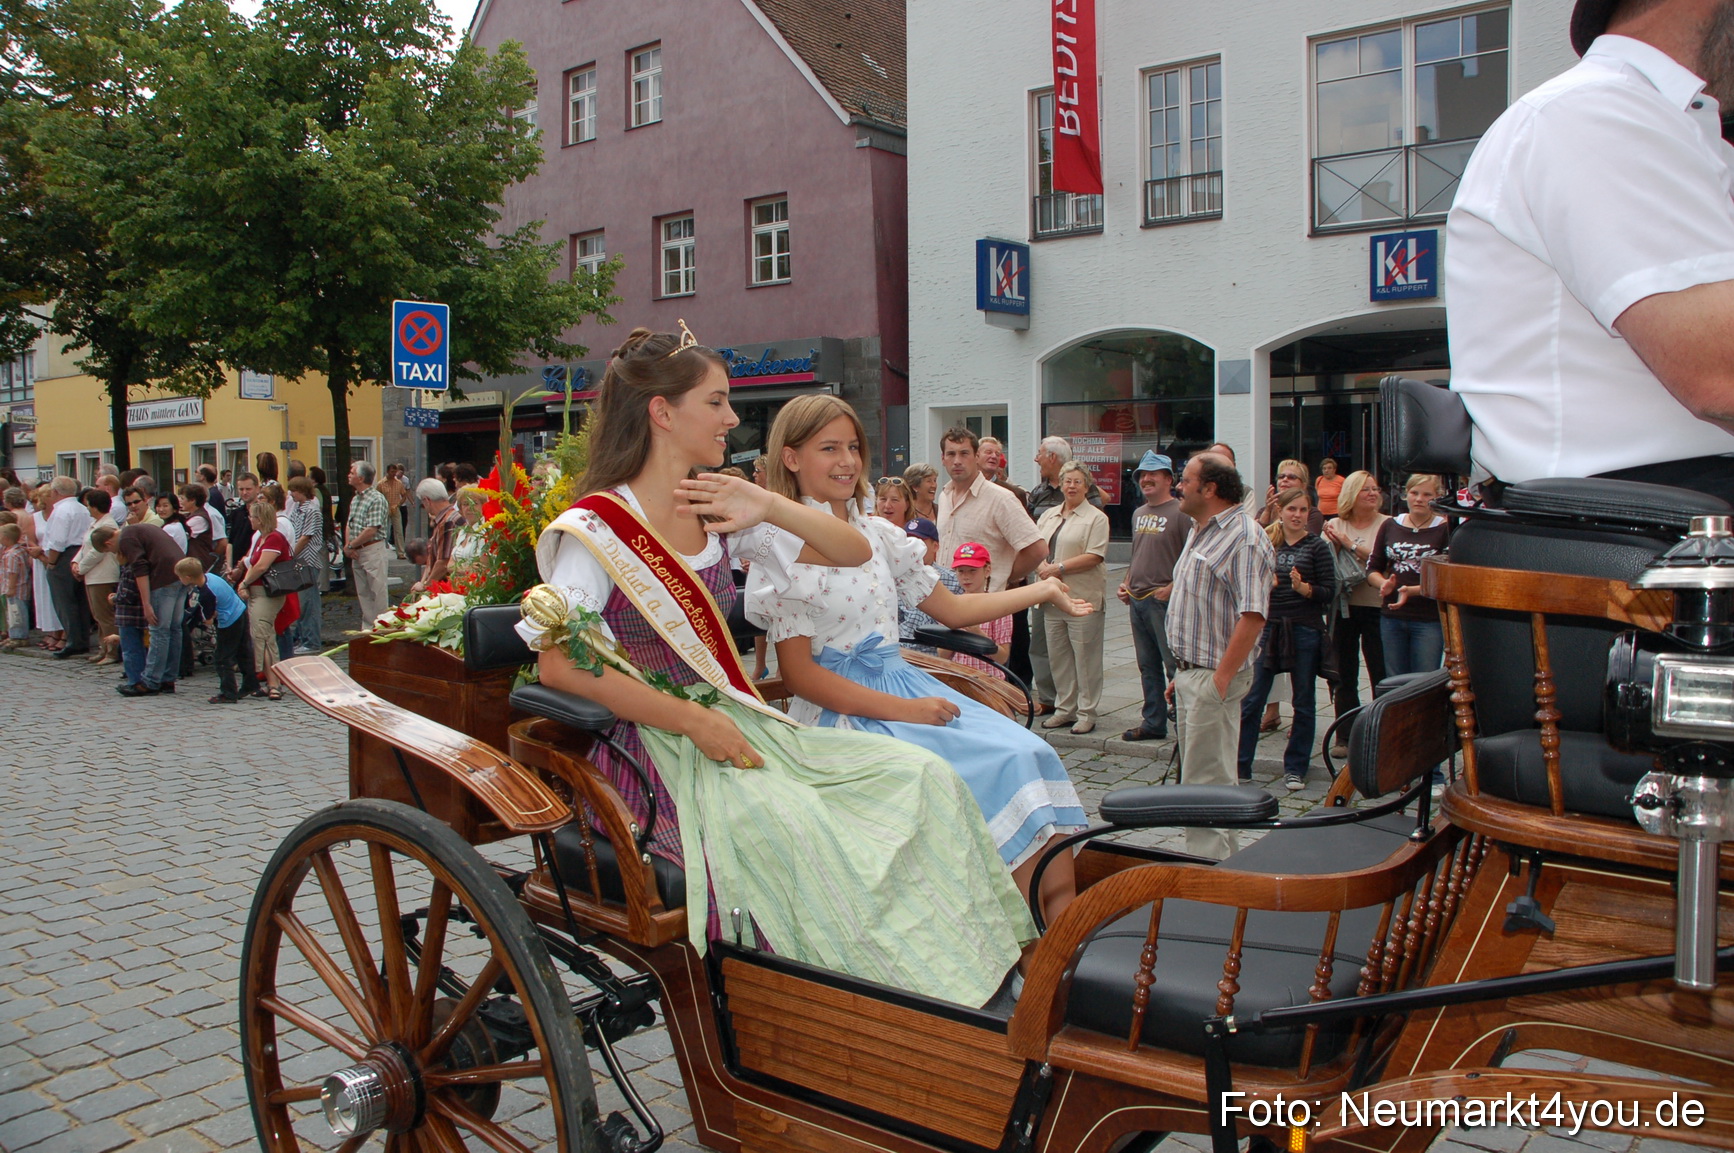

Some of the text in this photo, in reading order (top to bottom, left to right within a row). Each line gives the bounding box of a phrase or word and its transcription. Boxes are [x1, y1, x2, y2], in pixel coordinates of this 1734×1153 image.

[1376, 237, 1430, 287] K&L
[989, 246, 1026, 301] K&L
[1391, 284, 1428, 293] RUPPERT
[1001, 298, 1025, 307] RUPPERT
[398, 361, 442, 382] TAXI
[716, 347, 815, 377] Bäckerei
[150, 407, 177, 420] mittlere
[178, 401, 200, 417] GANS
[1072, 437, 1107, 445] NOCHMAL
[1072, 455, 1119, 463] REDUZIERTEN
[1134, 514, 1168, 532] 1962
[1277, 553, 1295, 565] 69
[600, 538, 652, 597] Dietfurt
[646, 599, 663, 618] a.
[663, 620, 686, 638] d.
[631, 534, 719, 659] Siebentälerkönigin
